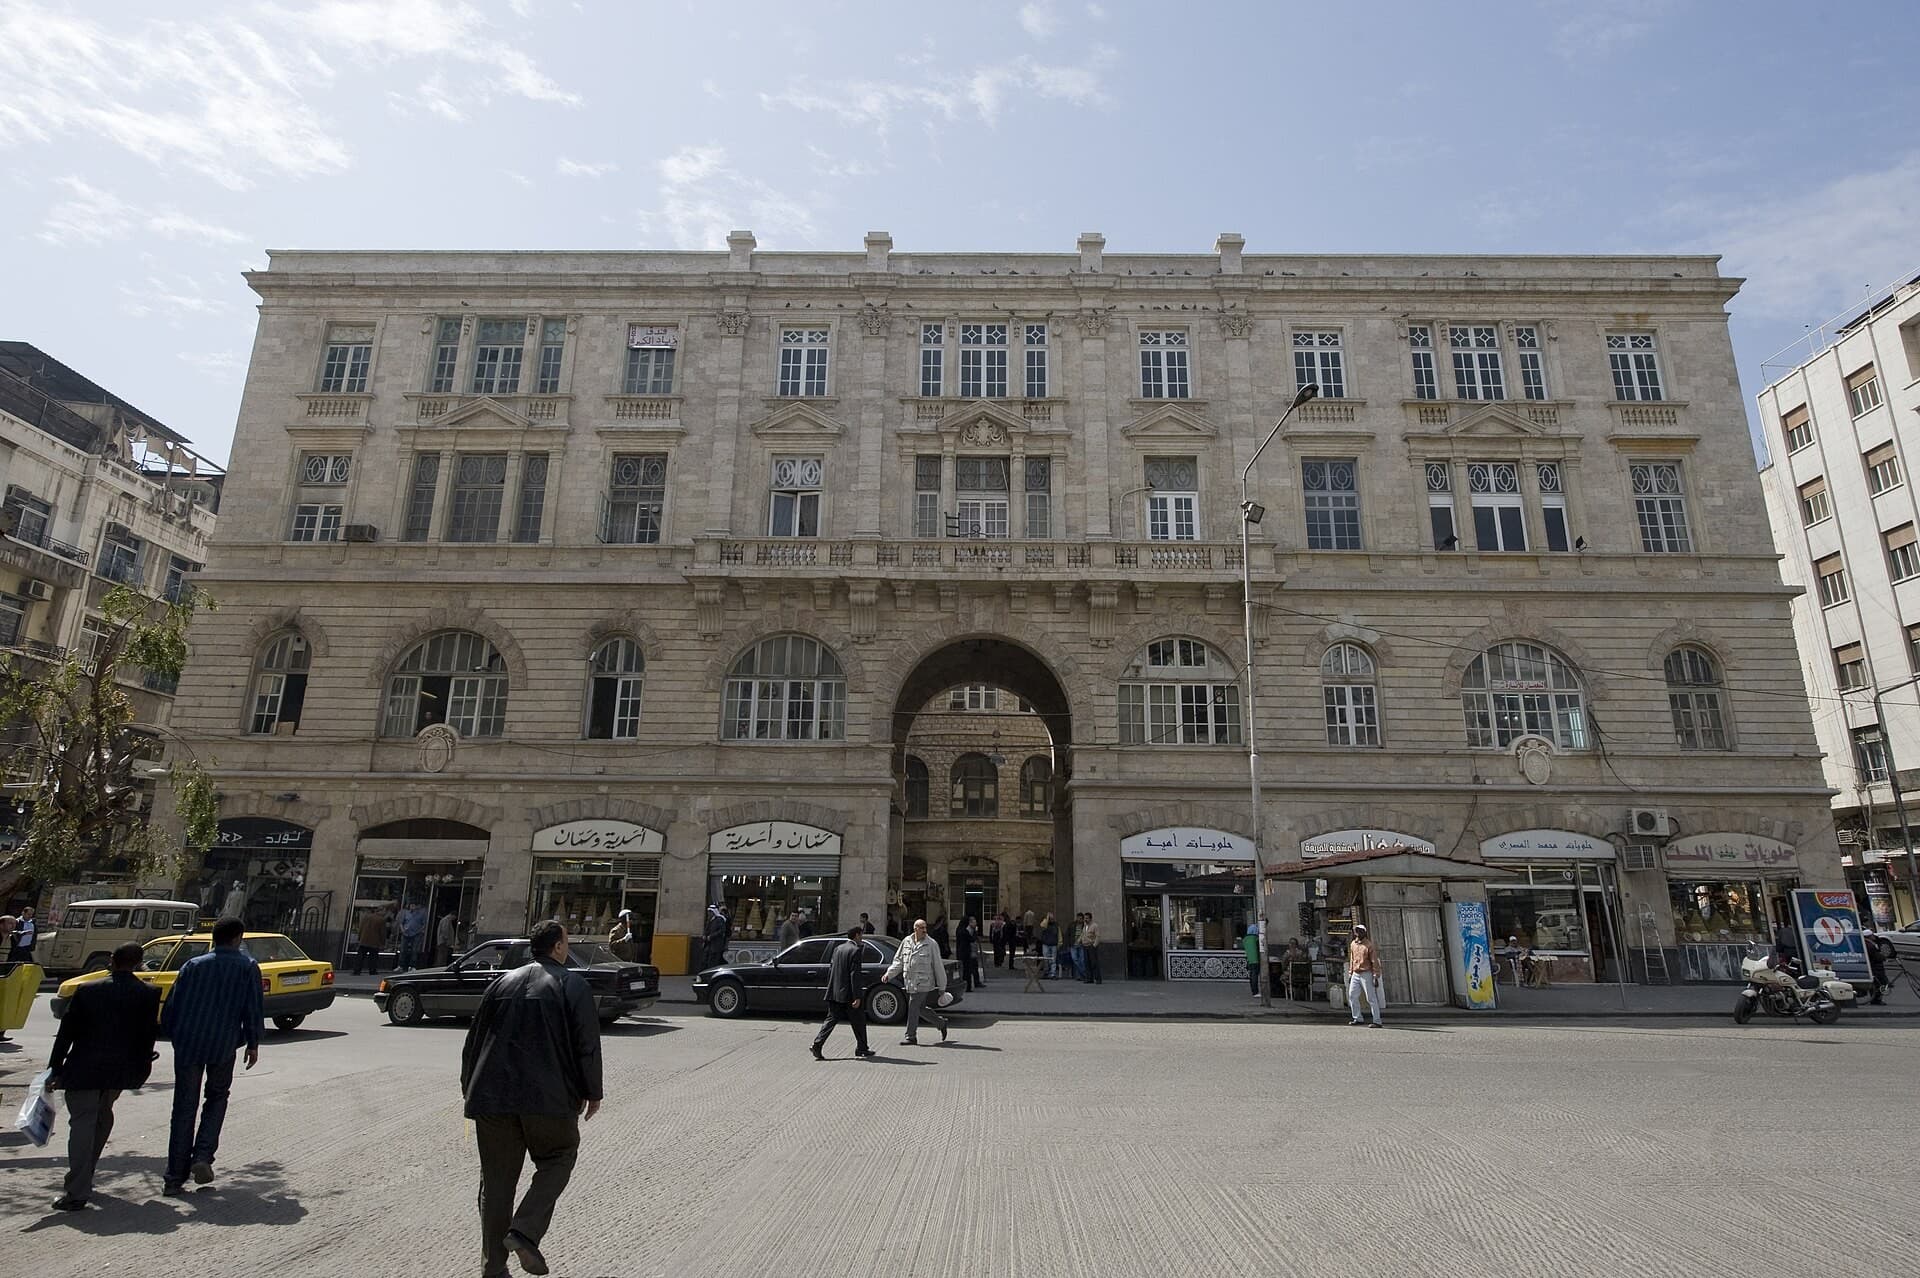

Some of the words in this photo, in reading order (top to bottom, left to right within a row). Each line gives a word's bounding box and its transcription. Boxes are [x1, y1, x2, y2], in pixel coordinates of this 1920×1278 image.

[646, 326, 667, 335] فندق
[1186, 836, 1234, 852] حلويات
[1565, 840, 1593, 851] حلويات
[1744, 842, 1795, 864] حلويات
